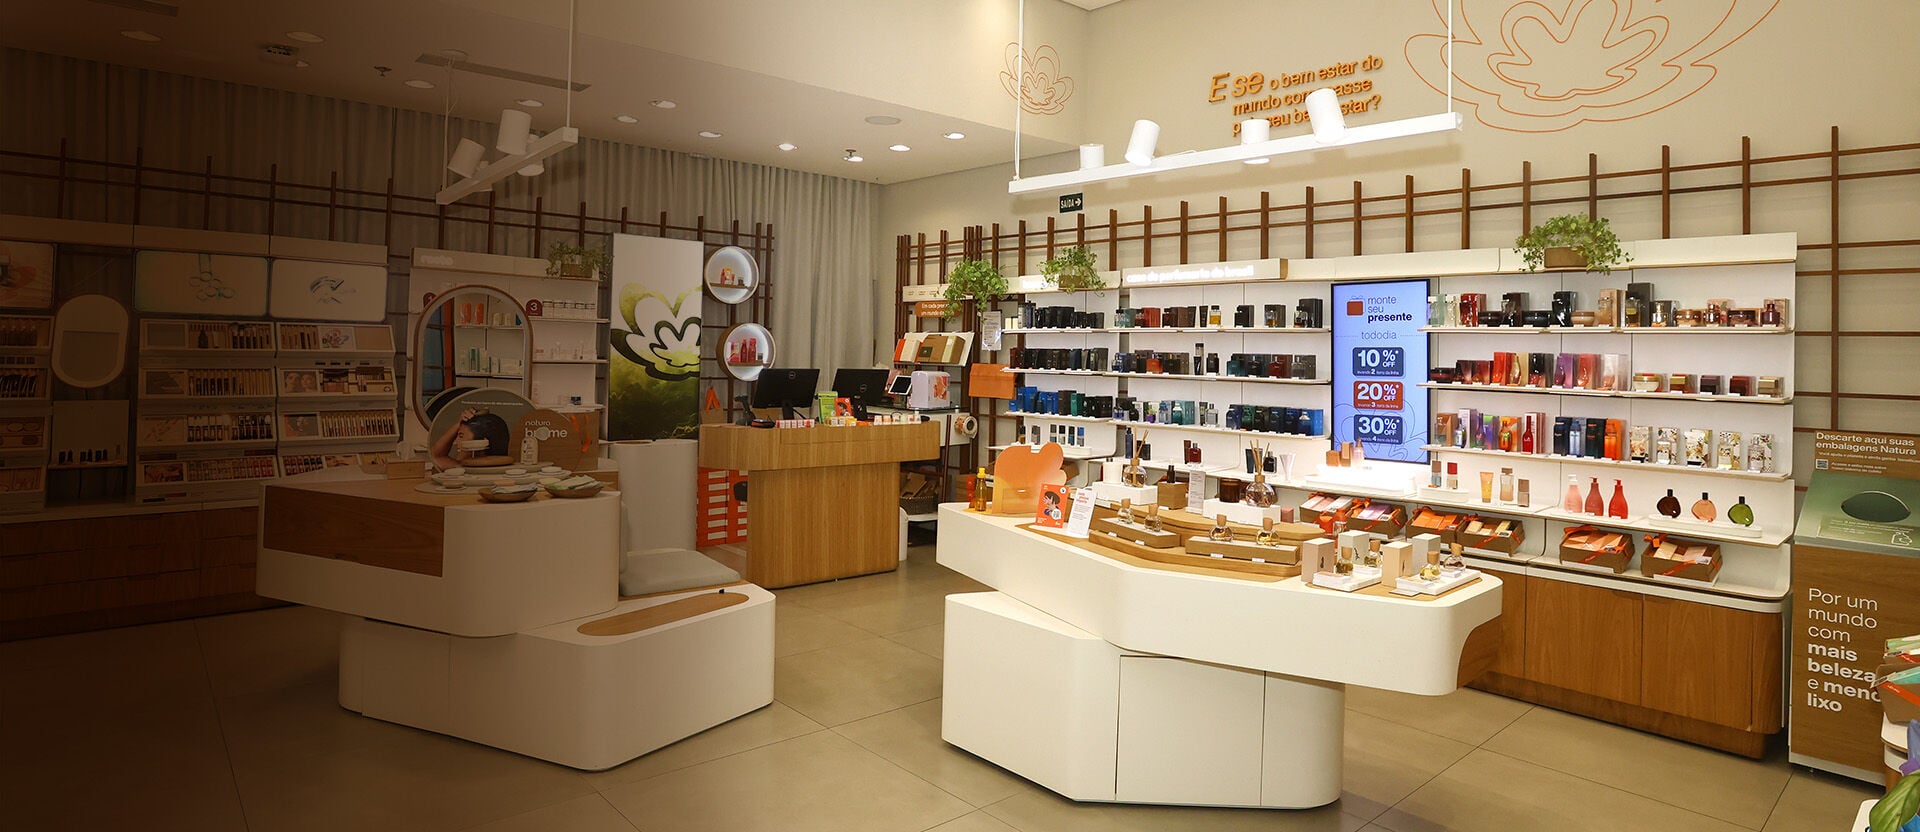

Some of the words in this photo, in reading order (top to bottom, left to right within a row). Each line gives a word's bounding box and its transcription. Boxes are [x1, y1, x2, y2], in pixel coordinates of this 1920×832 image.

[1209, 71, 1230, 103] E
[1231, 71, 1264, 98] se
[1269, 78, 1279, 90] o
[1282, 70, 1315, 88] bem
[1318, 60, 1358, 81] estar
[1361, 54, 1383, 72] do
[1233, 95, 1282, 116] mundo
[530, 302, 538, 311] 3
[1367, 296, 1397, 304] monte
[1367, 312, 1413, 324] presente
[1361, 330, 1397, 340] tododia
[1816, 432, 1862, 443] Descarte
[1864, 437, 1887, 445] aqui
[1816, 441, 1878, 453] embalagens
[1880, 446, 1917, 456] Natura
[1808, 588, 1842, 605] Por
[1847, 596, 1878, 611] um
[1808, 608, 1878, 629] mundo
[1808, 626, 1850, 643] com
[1808, 643, 1858, 661] mais
[1807, 658, 1877, 683] beleza
[1807, 678, 1819, 689] e
[1807, 692, 1843, 712] lixo
